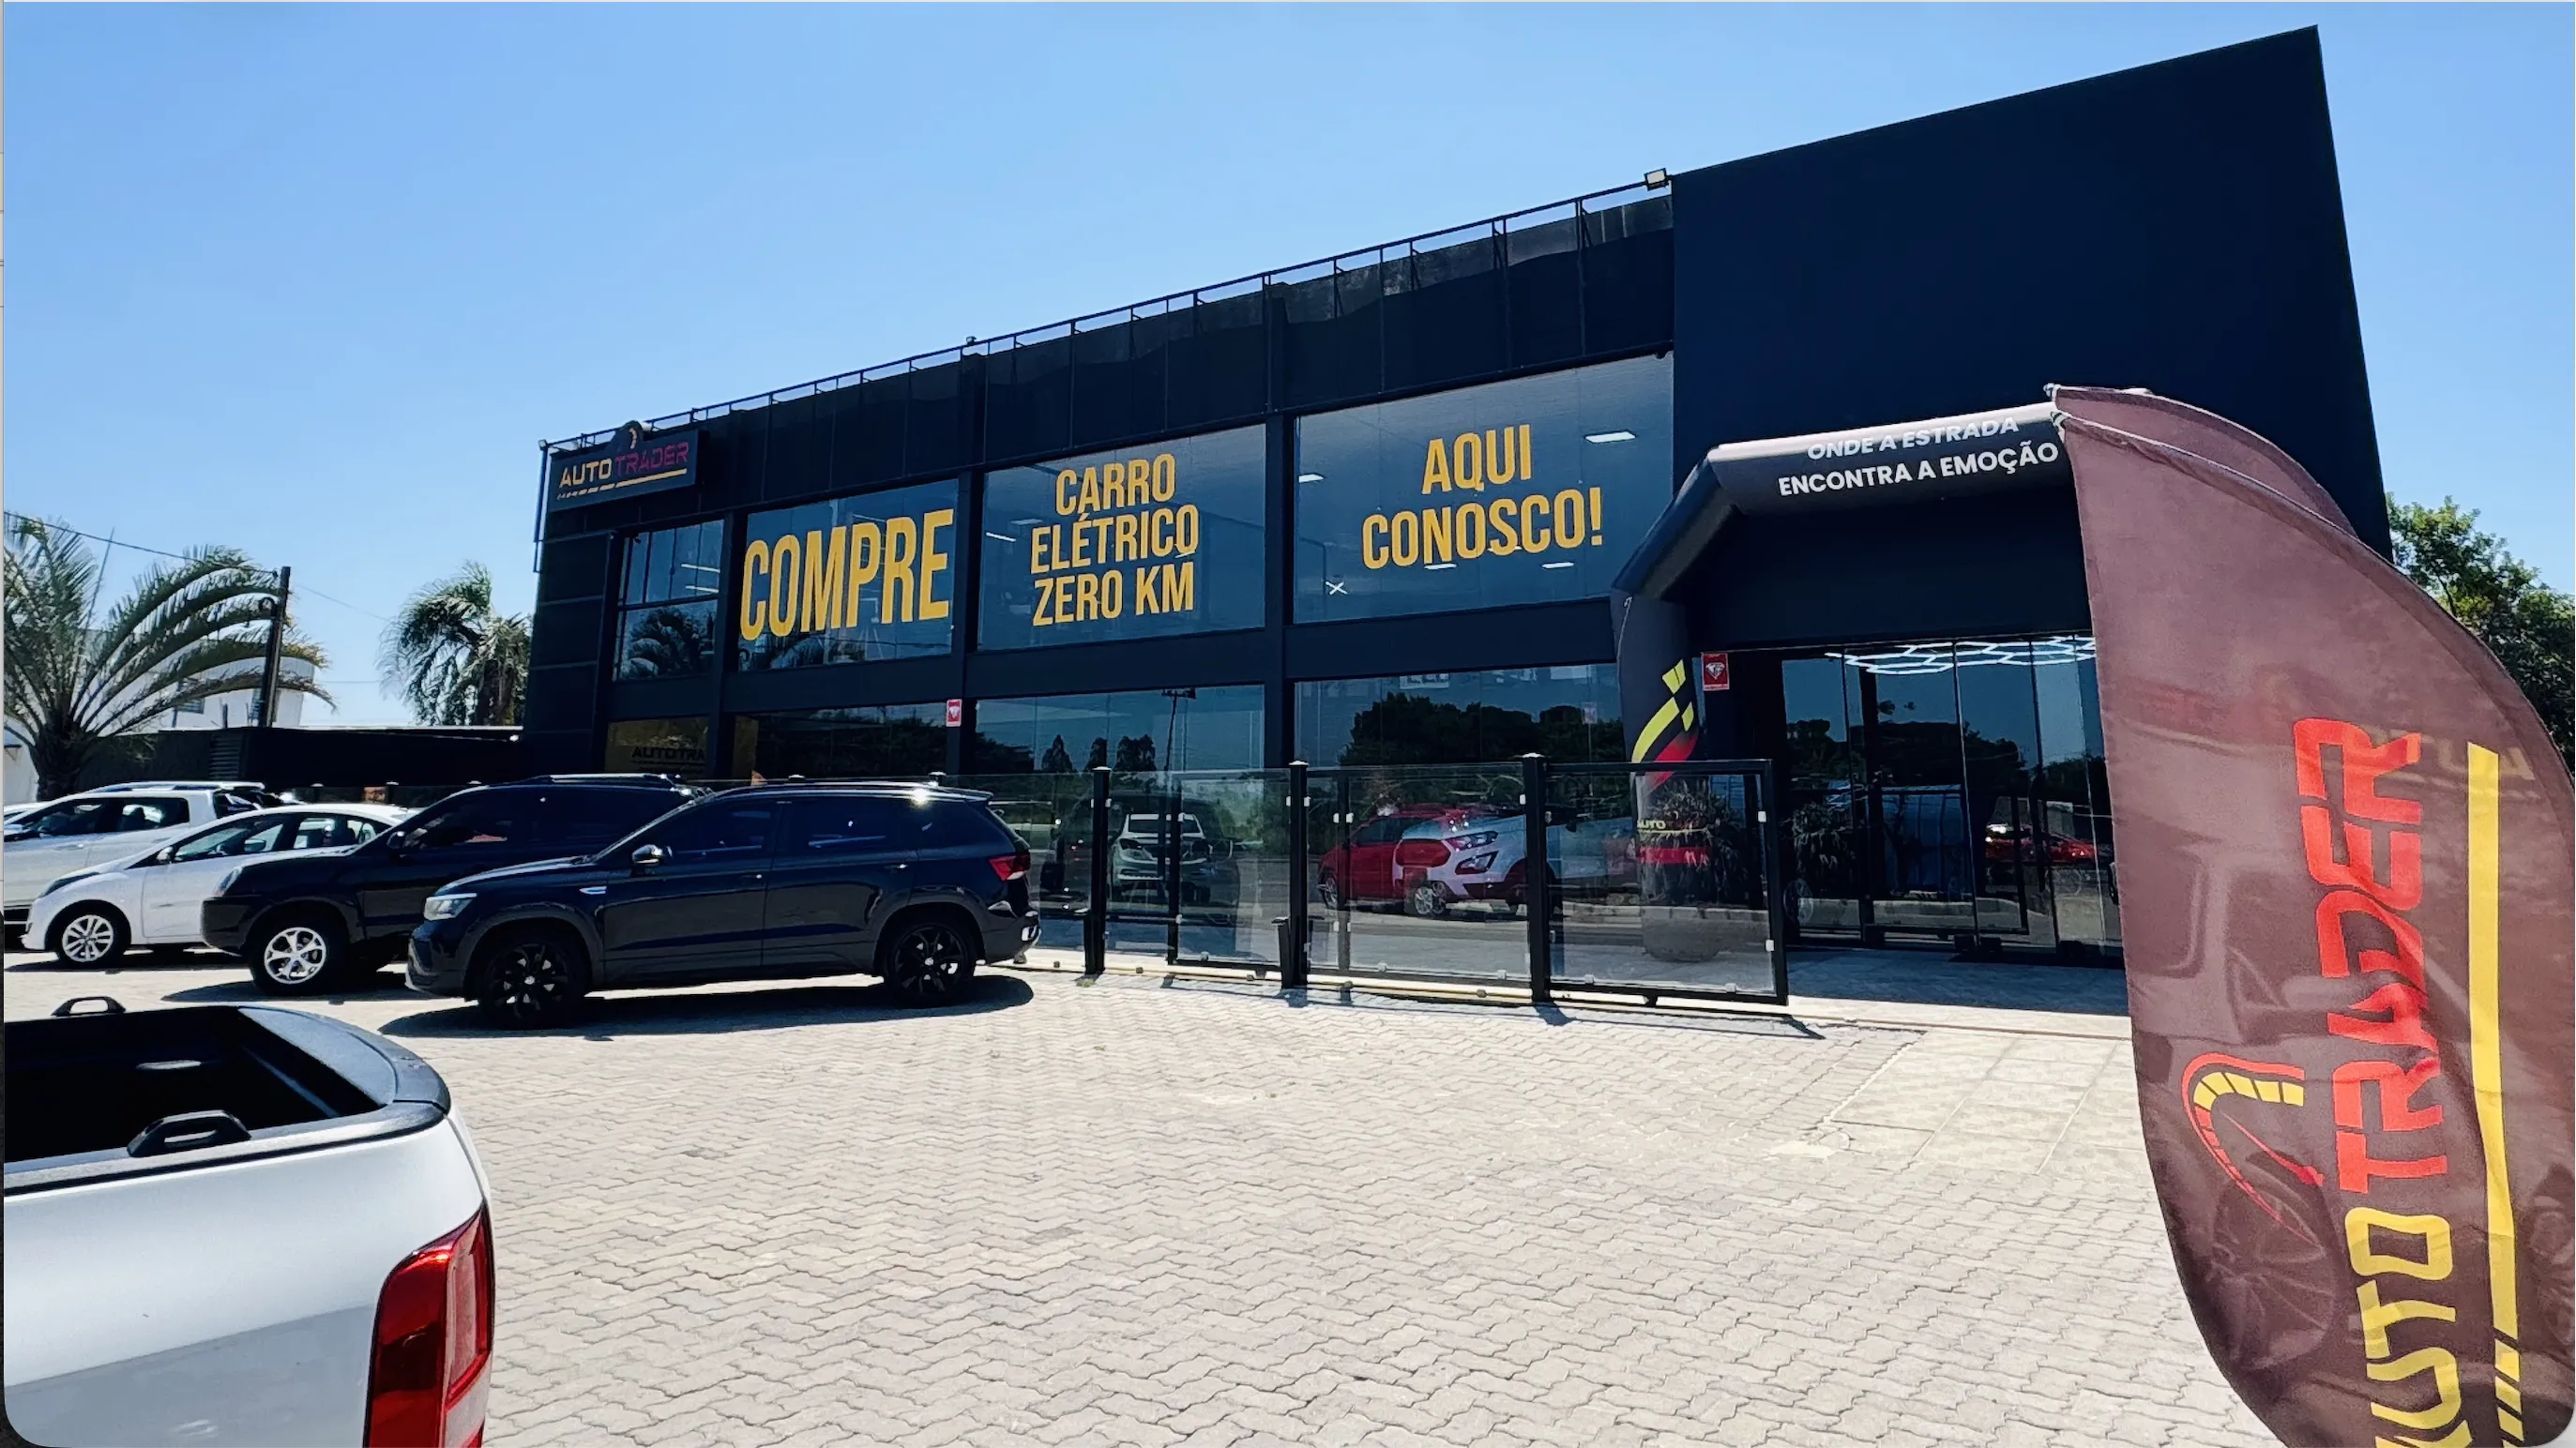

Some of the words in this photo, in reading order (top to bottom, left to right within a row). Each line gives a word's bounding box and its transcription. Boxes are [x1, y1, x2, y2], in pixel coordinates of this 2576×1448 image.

[559, 458, 613, 489] AUTO
[614, 442, 690, 477] TRADER
[1421, 424, 1532, 495] AQUI
[1778, 462, 1913, 497] ENCONTRA
[1917, 460, 1936, 481] A
[1939, 439, 2060, 475] EMOÇÃO
[1807, 437, 1874, 460] ONDE
[1878, 434, 1898, 452] A
[1902, 416, 2020, 449] ESTRADA
[1055, 453, 1175, 516] CARRO
[1030, 504, 1199, 575] ELÉTRICO
[1362, 487, 1603, 570] CONOSCO!
[739, 508, 955, 641] COMPRE
[1033, 569, 1124, 627] ZERO
[1135, 561, 1194, 616] KM
[2293, 716, 2447, 1194] TRADER
